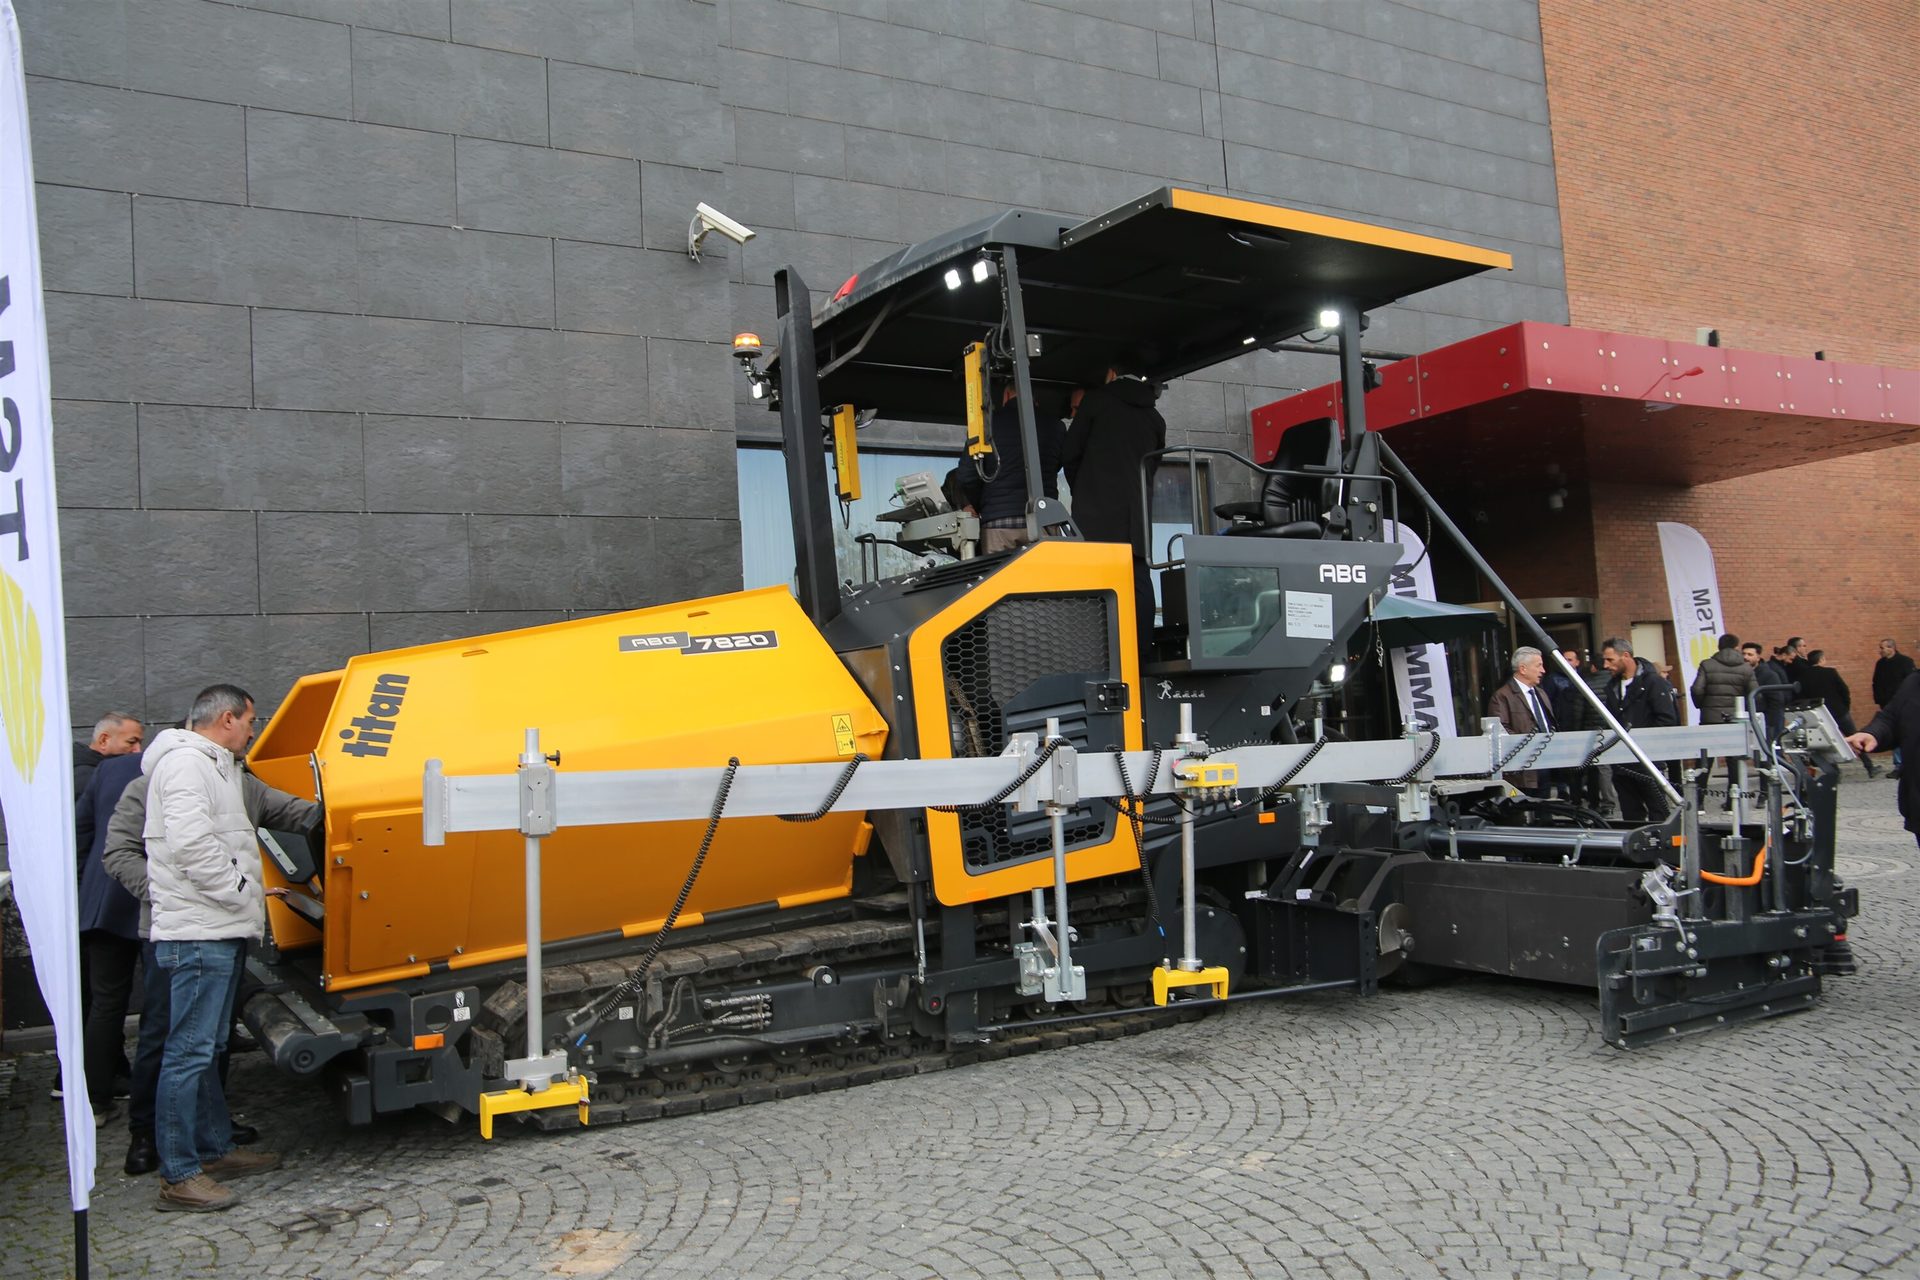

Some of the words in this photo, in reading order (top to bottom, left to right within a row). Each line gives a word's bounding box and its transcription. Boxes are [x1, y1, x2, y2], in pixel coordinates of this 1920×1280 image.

[1319, 563, 1367, 583] ABG
[632, 635, 678, 648] ABG
[695, 634, 769, 650] 7820
[339, 673, 410, 758] titan
